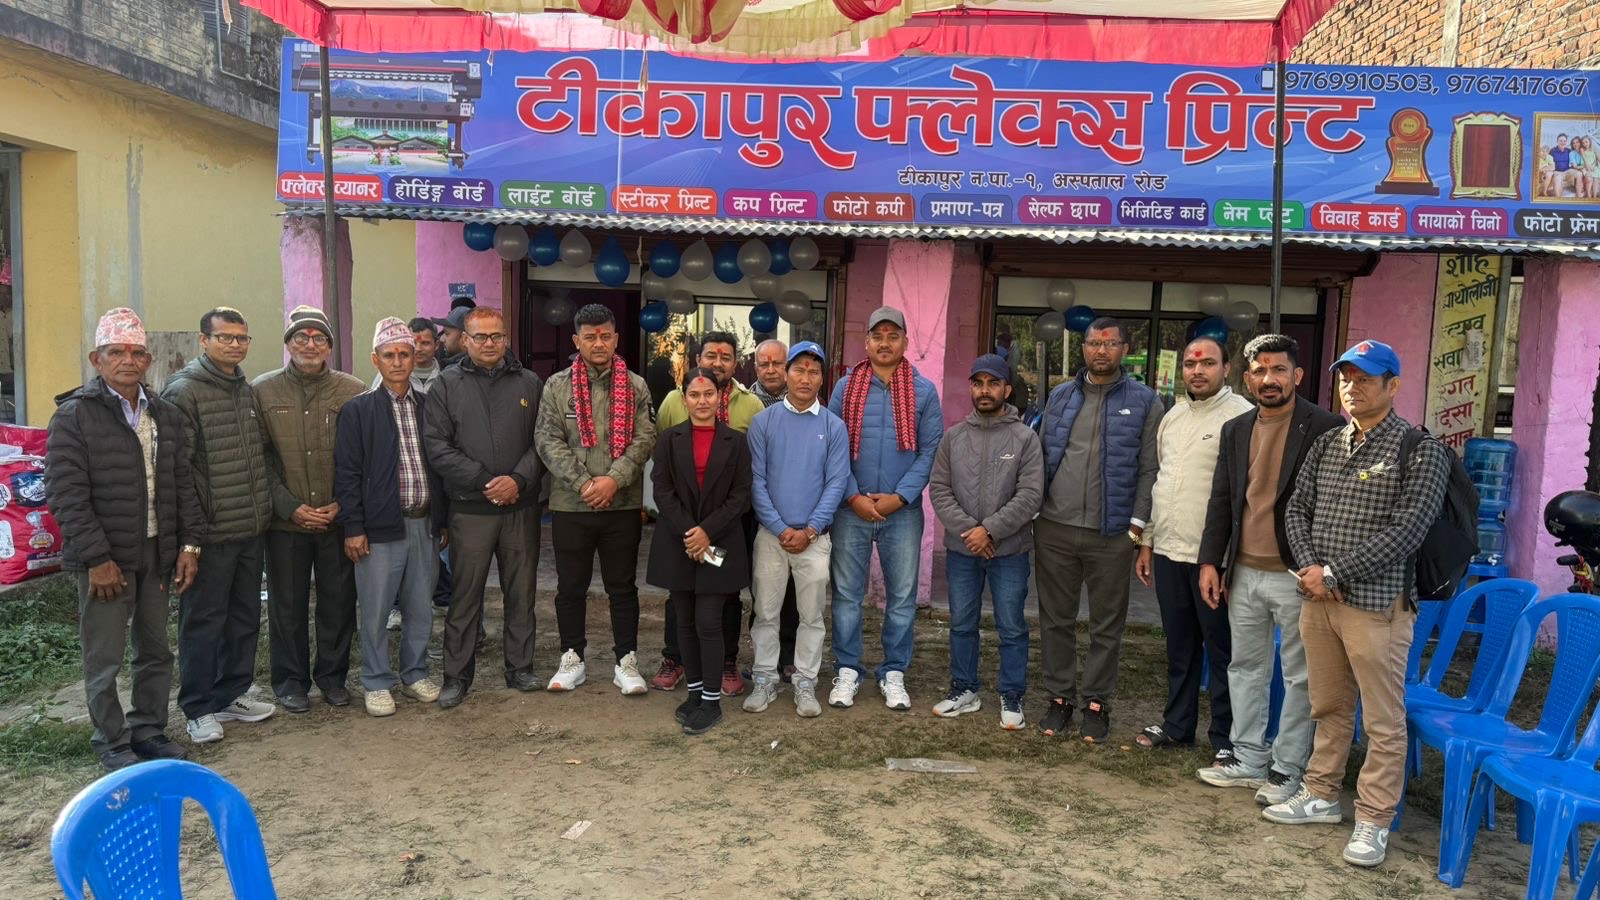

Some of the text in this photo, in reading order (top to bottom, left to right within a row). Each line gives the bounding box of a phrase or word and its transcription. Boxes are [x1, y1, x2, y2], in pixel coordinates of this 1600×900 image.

[1285, 70, 1588, 97] 9769910503, 9767417667
[515, 56, 1376, 170] टीकापुर फ्लेक्स प्रिन्ट
[898, 165, 964, 191] टीकापुर
[1053, 172, 1128, 191] अस्पताल
[1133, 171, 1168, 191] रोड
[452, 181, 486, 202] बोर्ड
[507, 183, 596, 207] लाईट बोर्ड
[619, 187, 712, 211] स्टीकर प्रिन्ट
[733, 192, 807, 214] कप प्रिन्ट
[832, 196, 905, 216] फोटो कपी
[930, 201, 1004, 219] प्रमाण-पत्र
[1028, 198, 1101, 220] सेल्फ छाप
[1180, 202, 1207, 221] कार्ड
[1223, 202, 1251, 222] नेम
[1319, 205, 1402, 230] विवाह कार्ड
[1418, 209, 1502, 231] मायाको चिनो
[1523, 212, 1600, 234] फोटो फ्रेम
